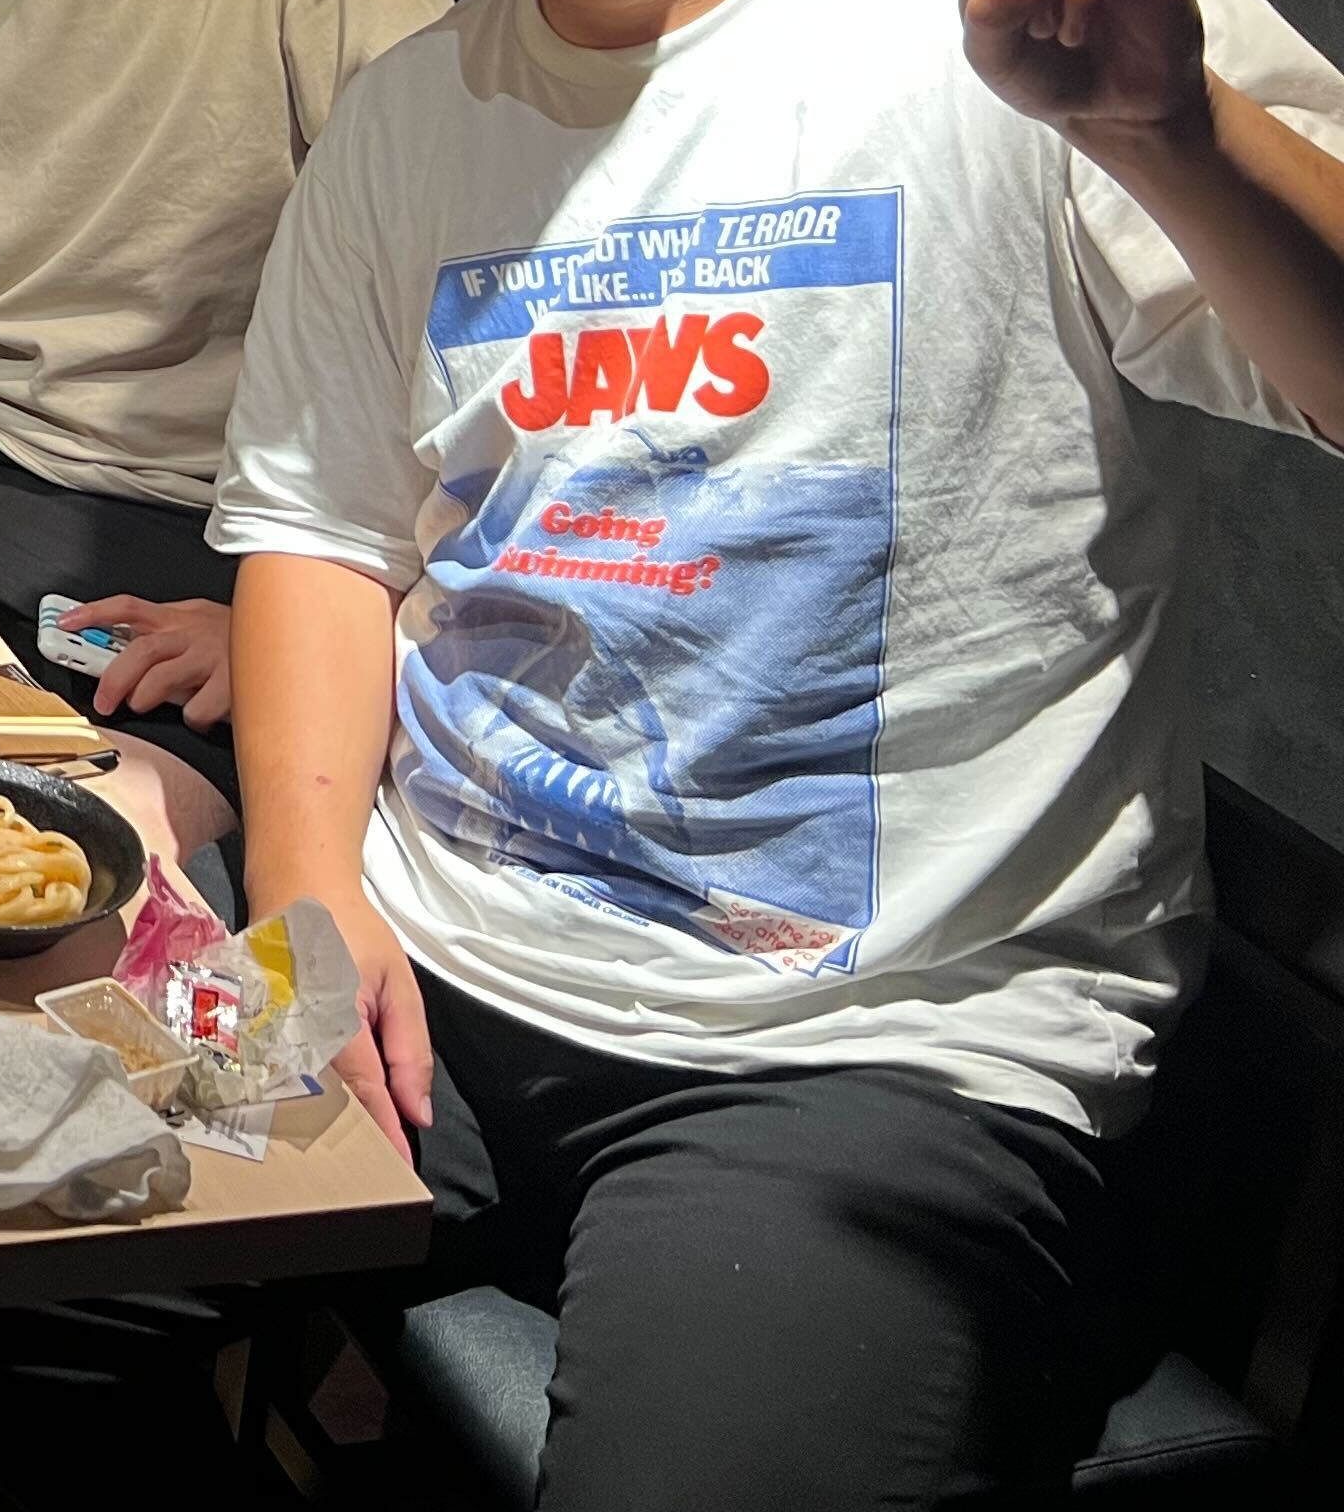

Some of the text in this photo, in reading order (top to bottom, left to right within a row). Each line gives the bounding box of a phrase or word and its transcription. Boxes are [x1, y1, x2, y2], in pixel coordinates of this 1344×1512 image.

[461, 205, 841, 298] IF YOU FOOT WHT TERROR
[694, 255, 772, 288] BACK
[500, 311, 771, 432] JAWS
[539, 500, 668, 550] Going
